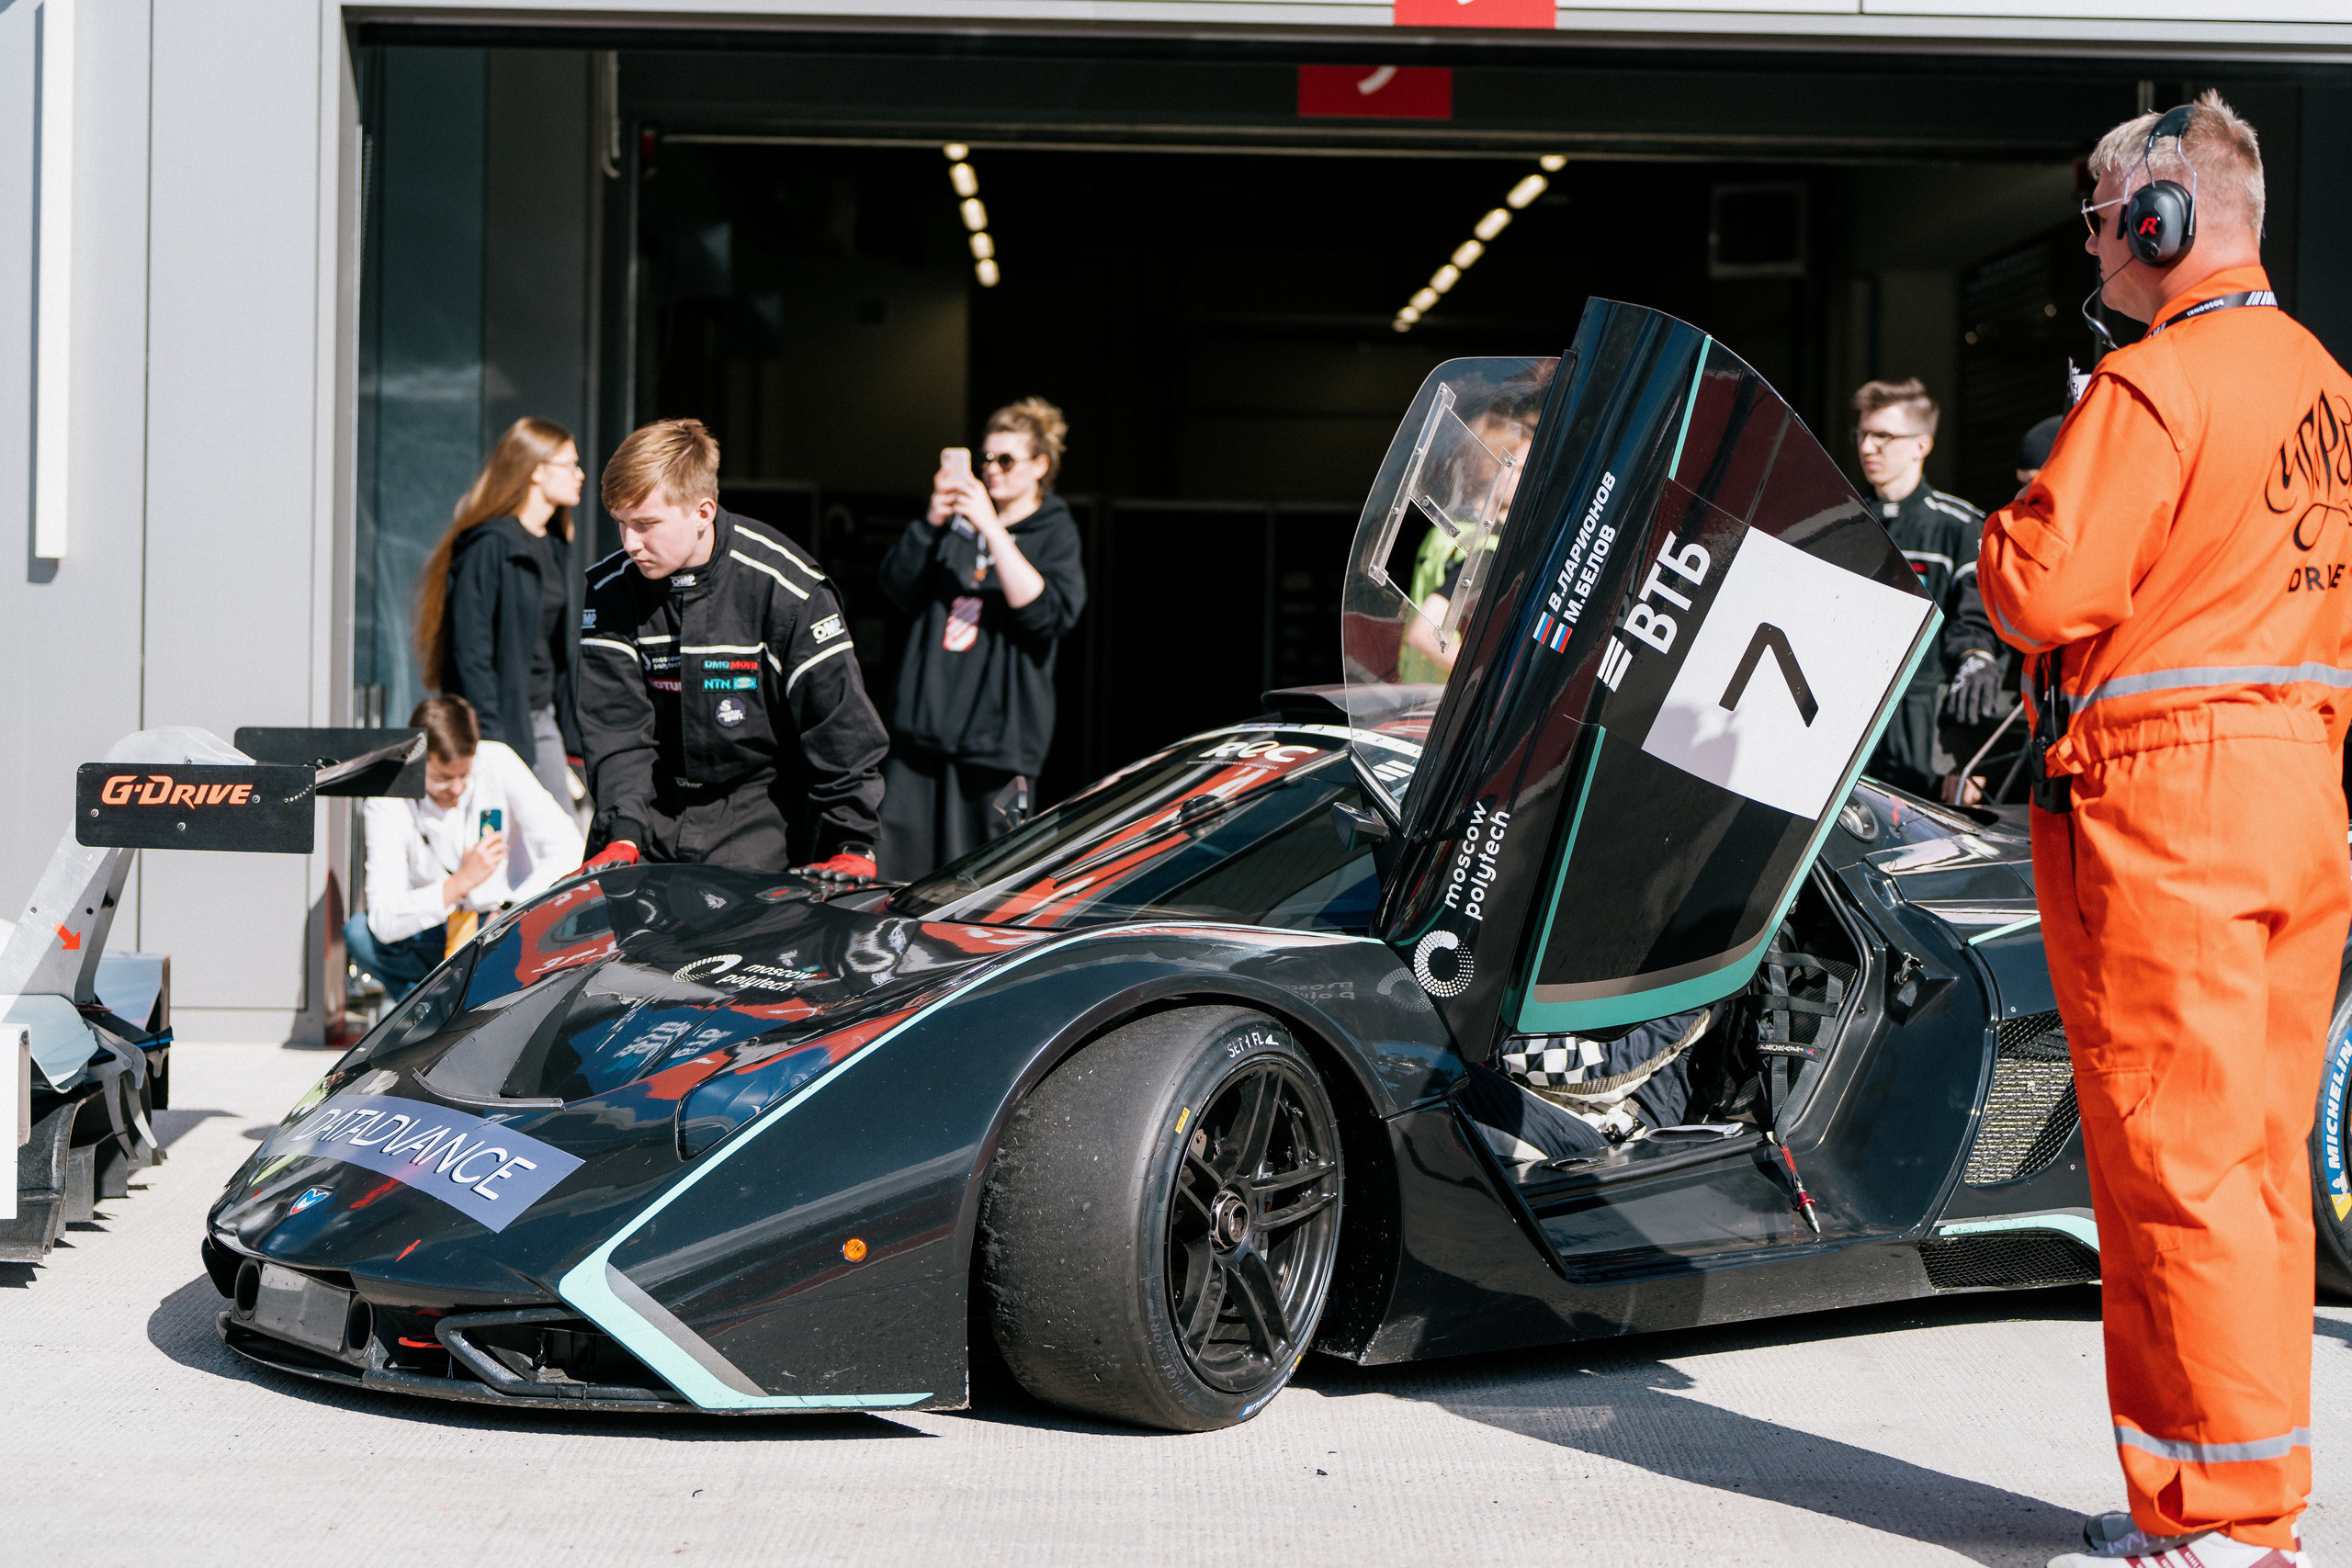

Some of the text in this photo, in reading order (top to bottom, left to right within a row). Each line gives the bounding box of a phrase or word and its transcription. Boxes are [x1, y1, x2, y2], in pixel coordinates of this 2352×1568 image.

[2139, 217, 2157, 234] R
[1547, 471, 1616, 613] В.ЛАРИОНОВ
[1563, 525, 1616, 624] М.БЕЛОВ
[812, 615, 842, 642] OMP
[1623, 530, 1711, 655] ВТБ
[704, 679, 730, 690] NTN
[1719, 622, 1819, 728] 7
[1444, 801, 1487, 908] moscow
[1464, 811, 1510, 921] polytech
[715, 974, 793, 991] polytech
[742, 964, 817, 980] moscow
[1227, 1038, 1245, 1058] SET
[2325, 1039, 2352, 1169] MICHELIN
[291, 1108, 537, 1201] DATADVANCE
[1161, 1365, 1188, 1395] PILOT
